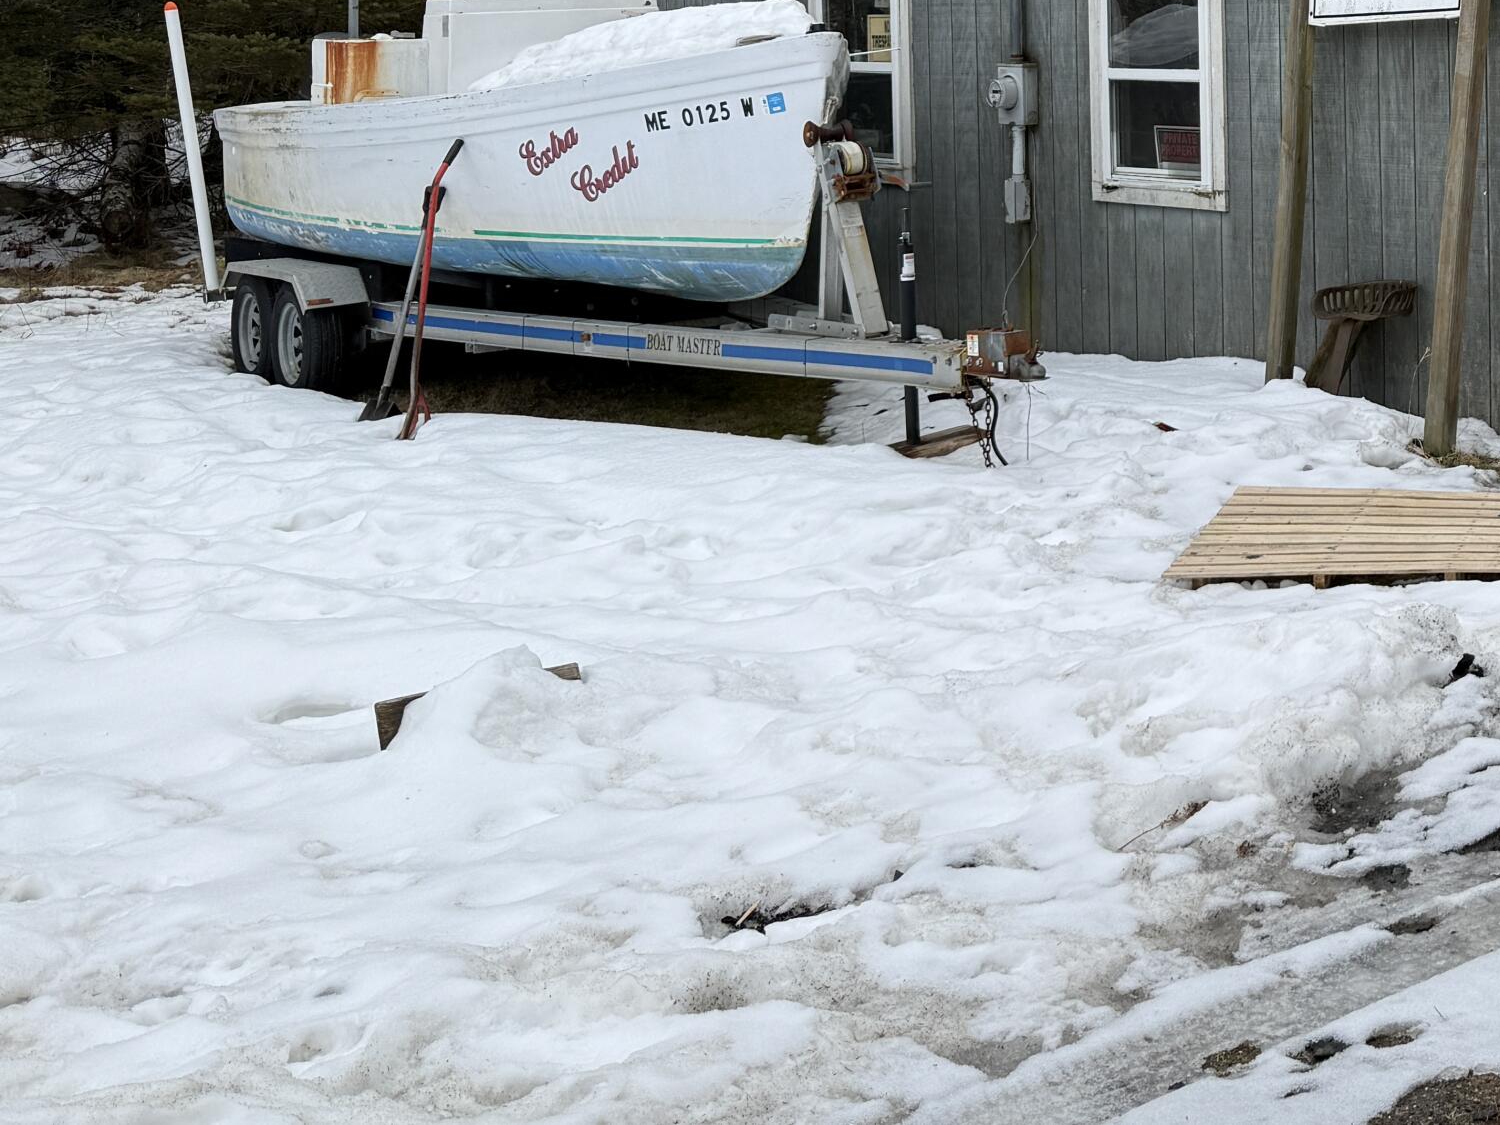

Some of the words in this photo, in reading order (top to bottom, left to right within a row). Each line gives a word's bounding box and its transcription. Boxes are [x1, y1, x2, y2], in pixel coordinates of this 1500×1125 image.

[644, 110, 671, 133] ME
[681, 101, 731, 127] 0125
[740, 97, 755, 118] W
[519, 126, 579, 176] Extra
[570, 139, 639, 202] Credit
[646, 332, 674, 352] BOAT
[677, 335, 721, 356] MASTER
